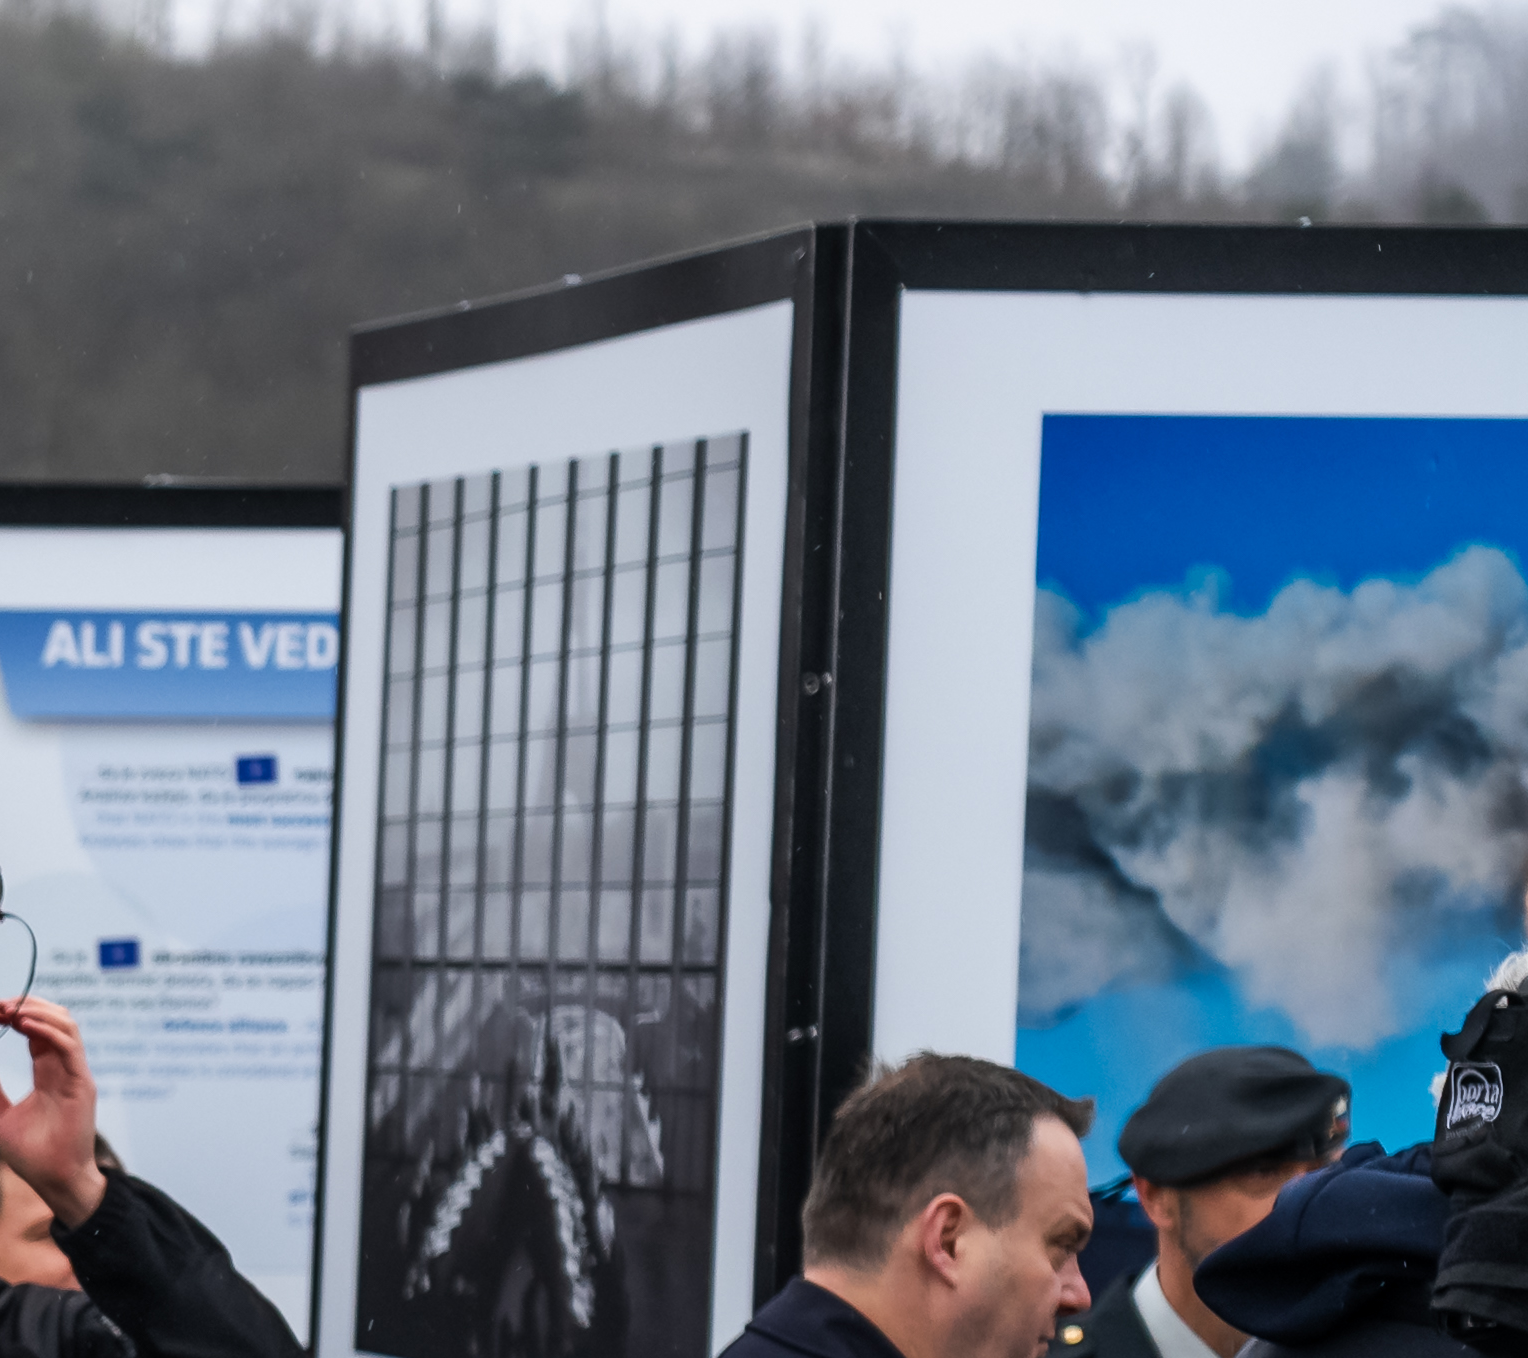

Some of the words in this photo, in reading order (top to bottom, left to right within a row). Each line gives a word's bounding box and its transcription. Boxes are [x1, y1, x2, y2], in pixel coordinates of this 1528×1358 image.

[41, 619, 126, 669] ALI
[135, 619, 229, 670] STE
[237, 620, 338, 670] VED
